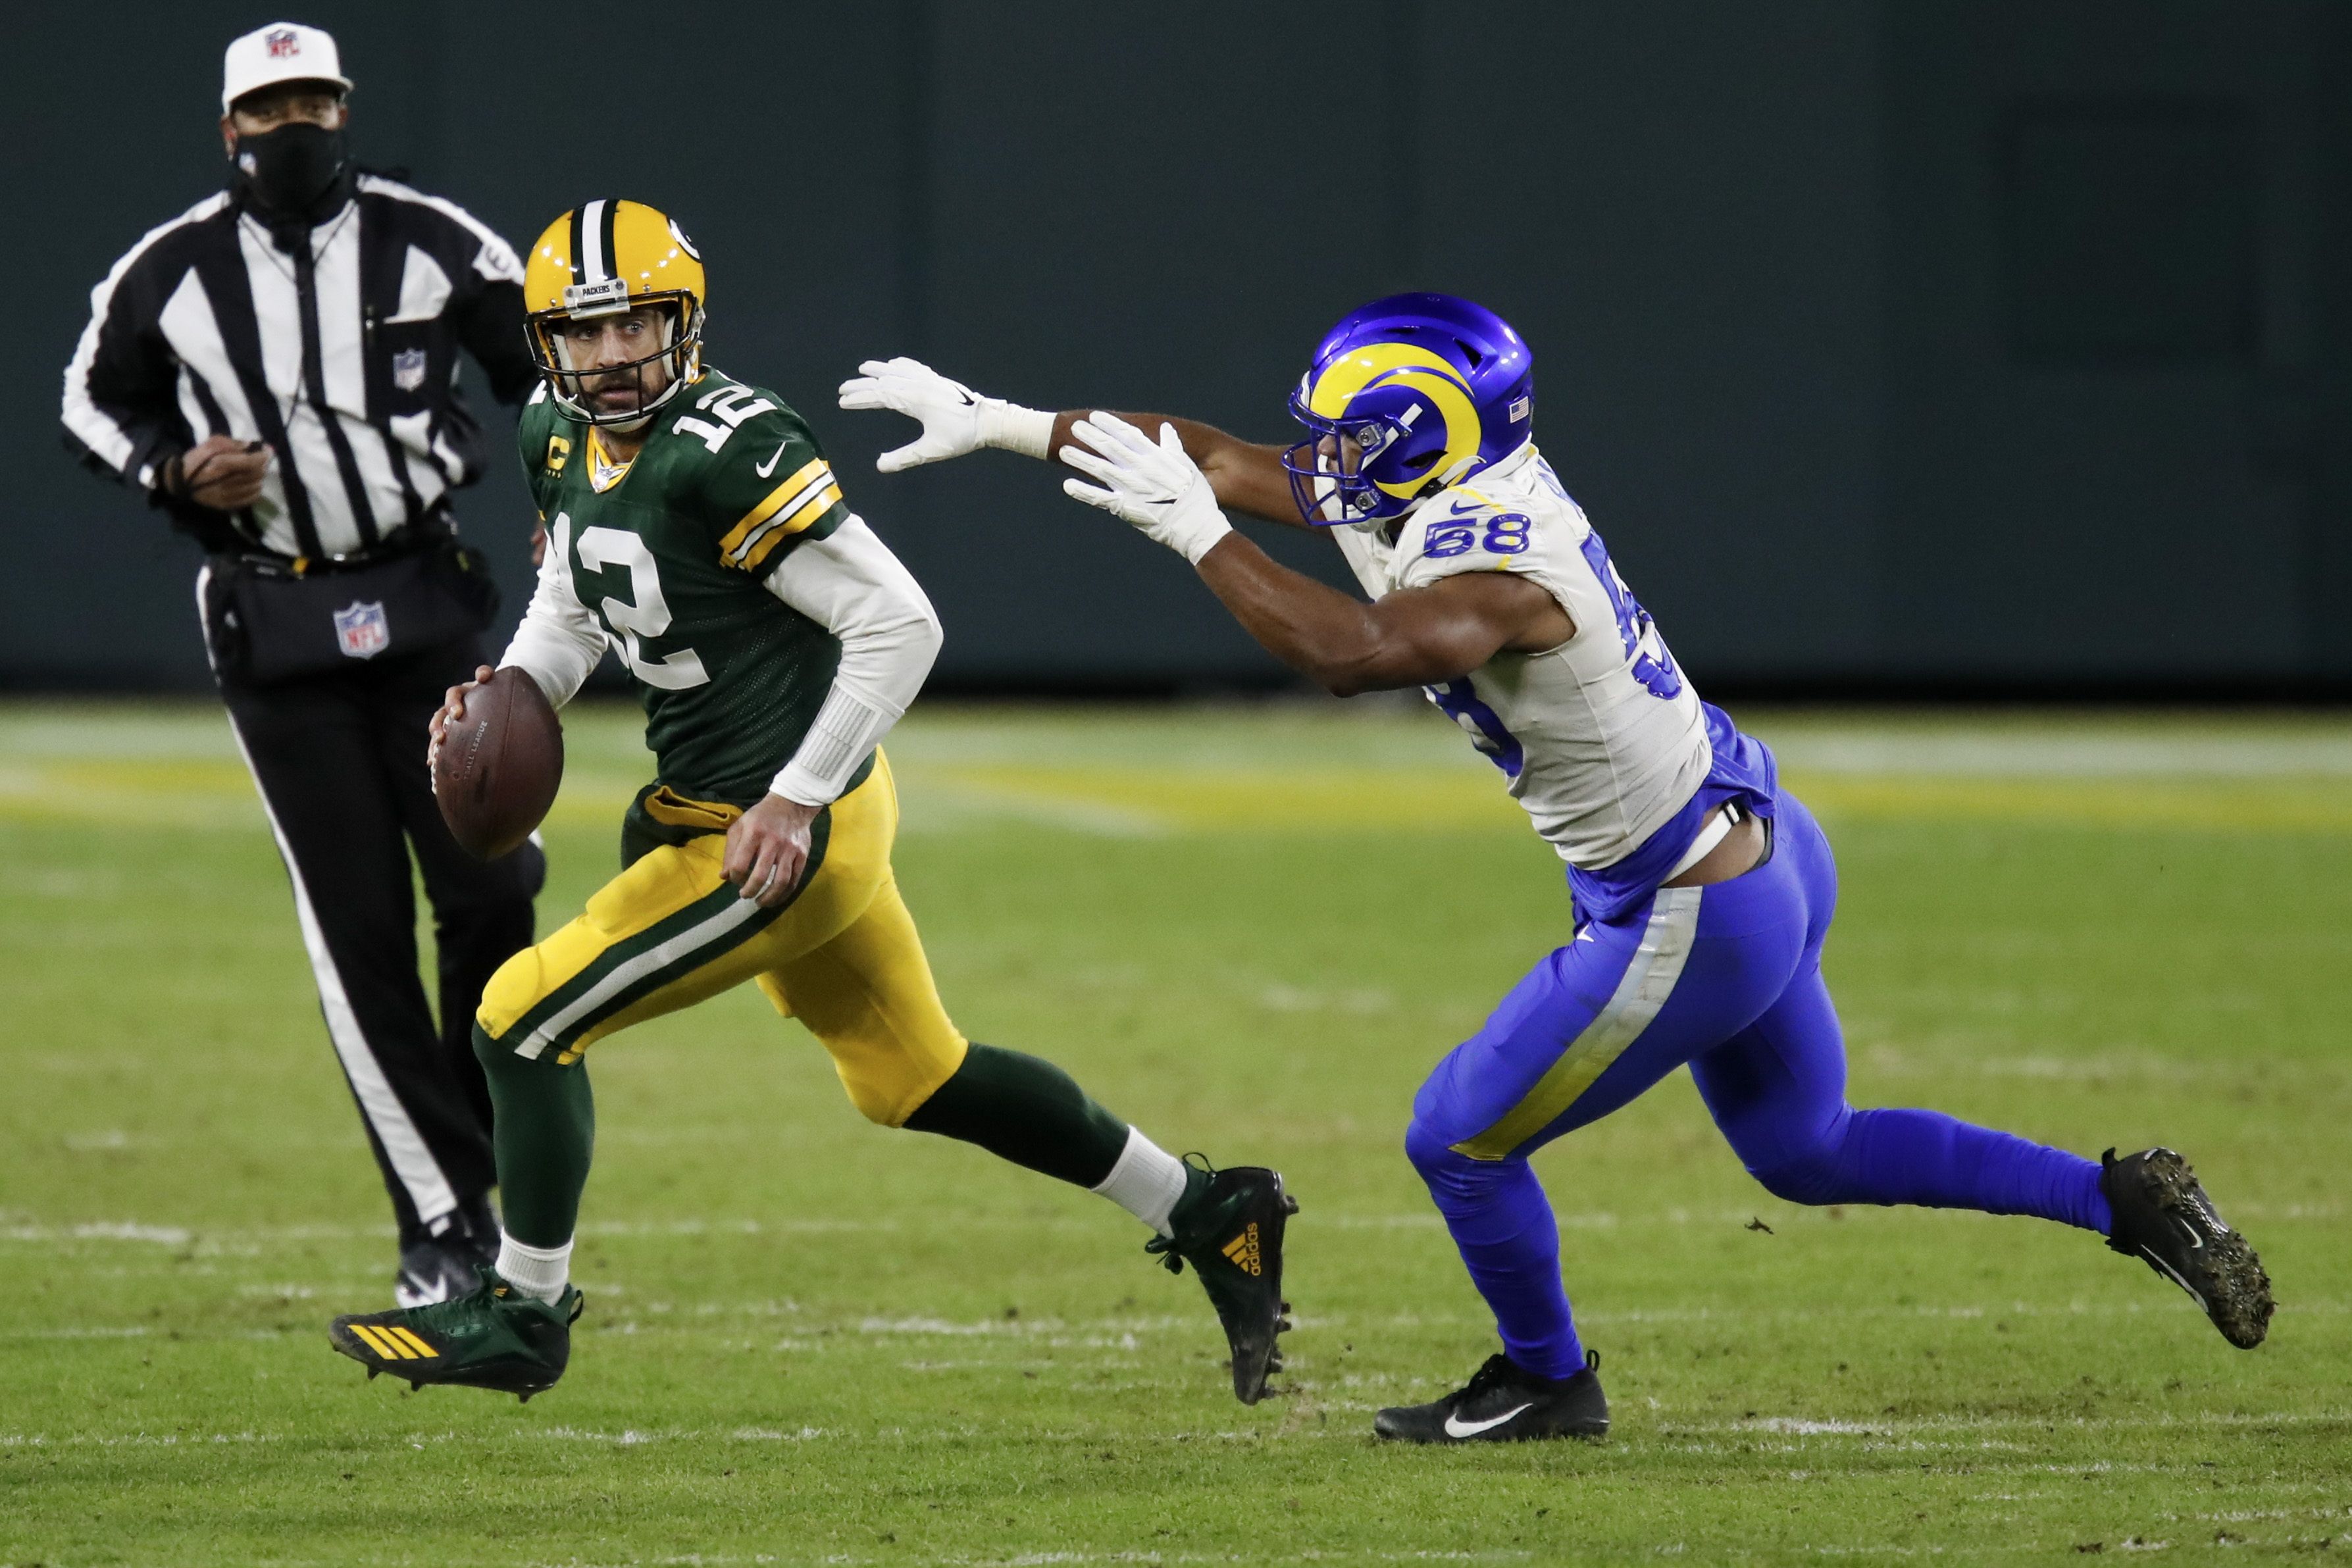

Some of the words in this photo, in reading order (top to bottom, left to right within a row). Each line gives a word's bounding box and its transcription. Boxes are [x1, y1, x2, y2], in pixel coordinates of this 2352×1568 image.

[582, 285, 610, 296] PACKERS
[673, 386, 777, 454] 12
[548, 436, 570, 469] C
[1424, 513, 1531, 558] 58
[345, 622, 384, 649] NFL
[471, 721, 488, 752] LEAGUE
[1246, 1223, 1261, 1276] adidas
